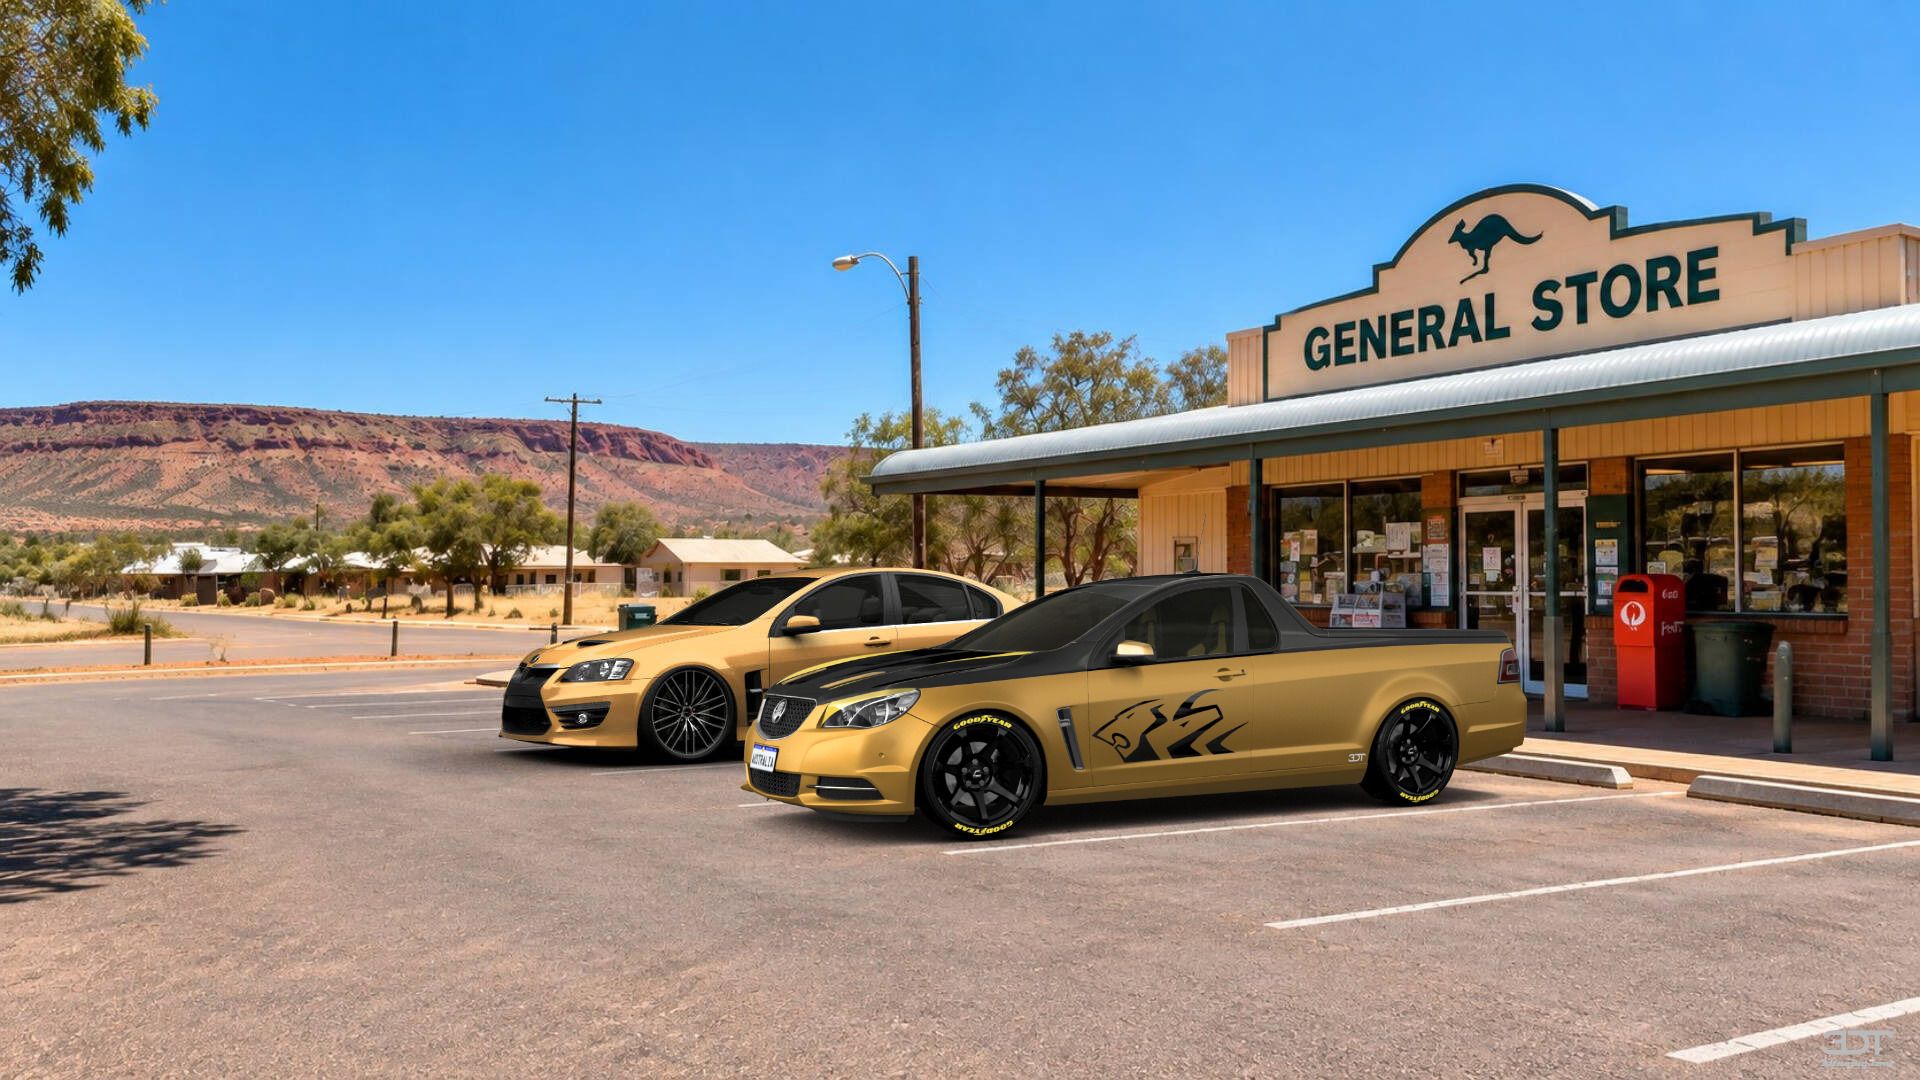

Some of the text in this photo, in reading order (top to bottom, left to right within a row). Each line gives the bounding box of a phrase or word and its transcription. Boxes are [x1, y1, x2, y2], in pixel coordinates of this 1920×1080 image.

[1304, 246, 1719, 370] GENERAL STORE
[1401, 701, 1439, 714] GOODYEAR
[953, 715, 1012, 729] GOODYEAR
[1400, 789, 1439, 802] GOODYEAR
[954, 820, 1013, 835] GOODYEAR
